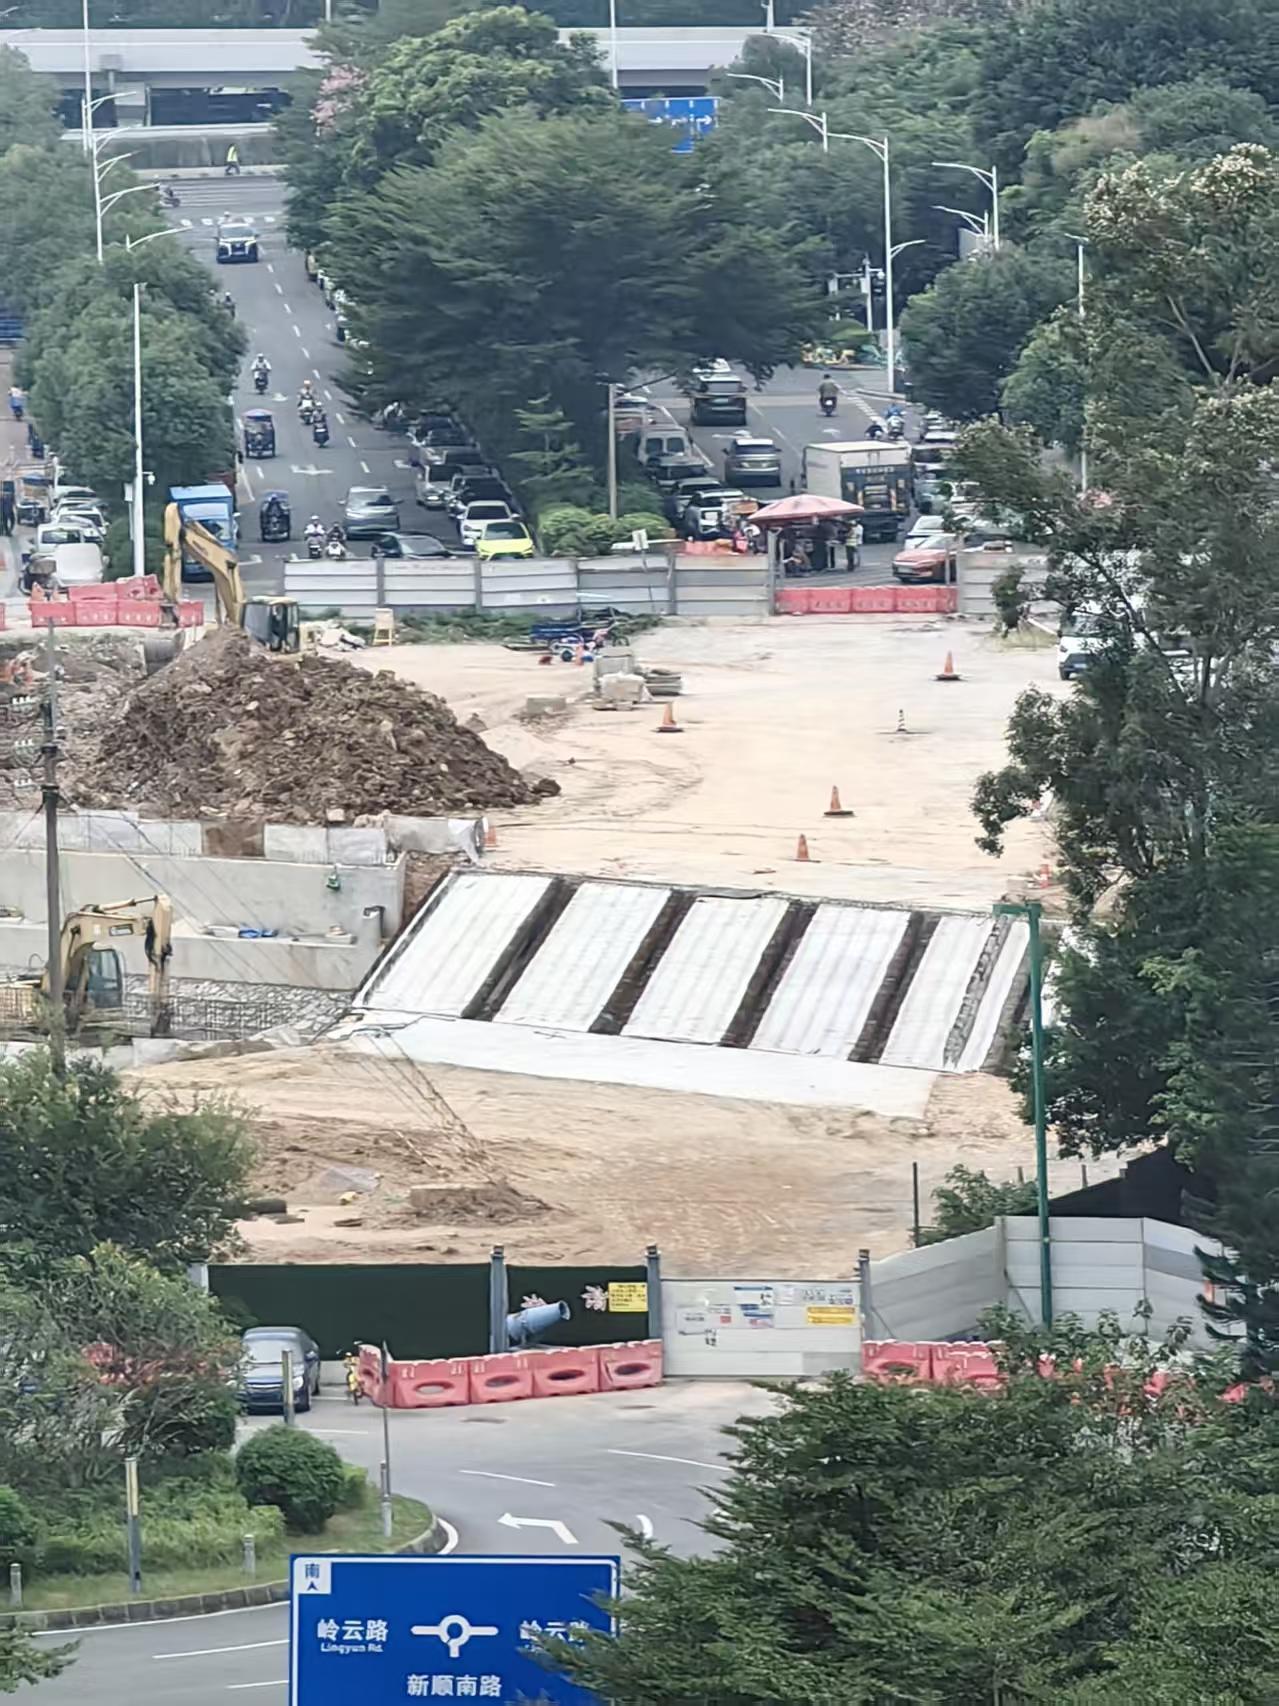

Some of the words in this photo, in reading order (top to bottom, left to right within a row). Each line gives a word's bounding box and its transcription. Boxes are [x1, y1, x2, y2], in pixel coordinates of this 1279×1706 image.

[304, 1563, 320, 1579] 南
[317, 1618, 388, 1642] 岭云路
[320, 1642, 366, 1654] Lingyun
[407, 1674, 502, 1697] 新顺南路
